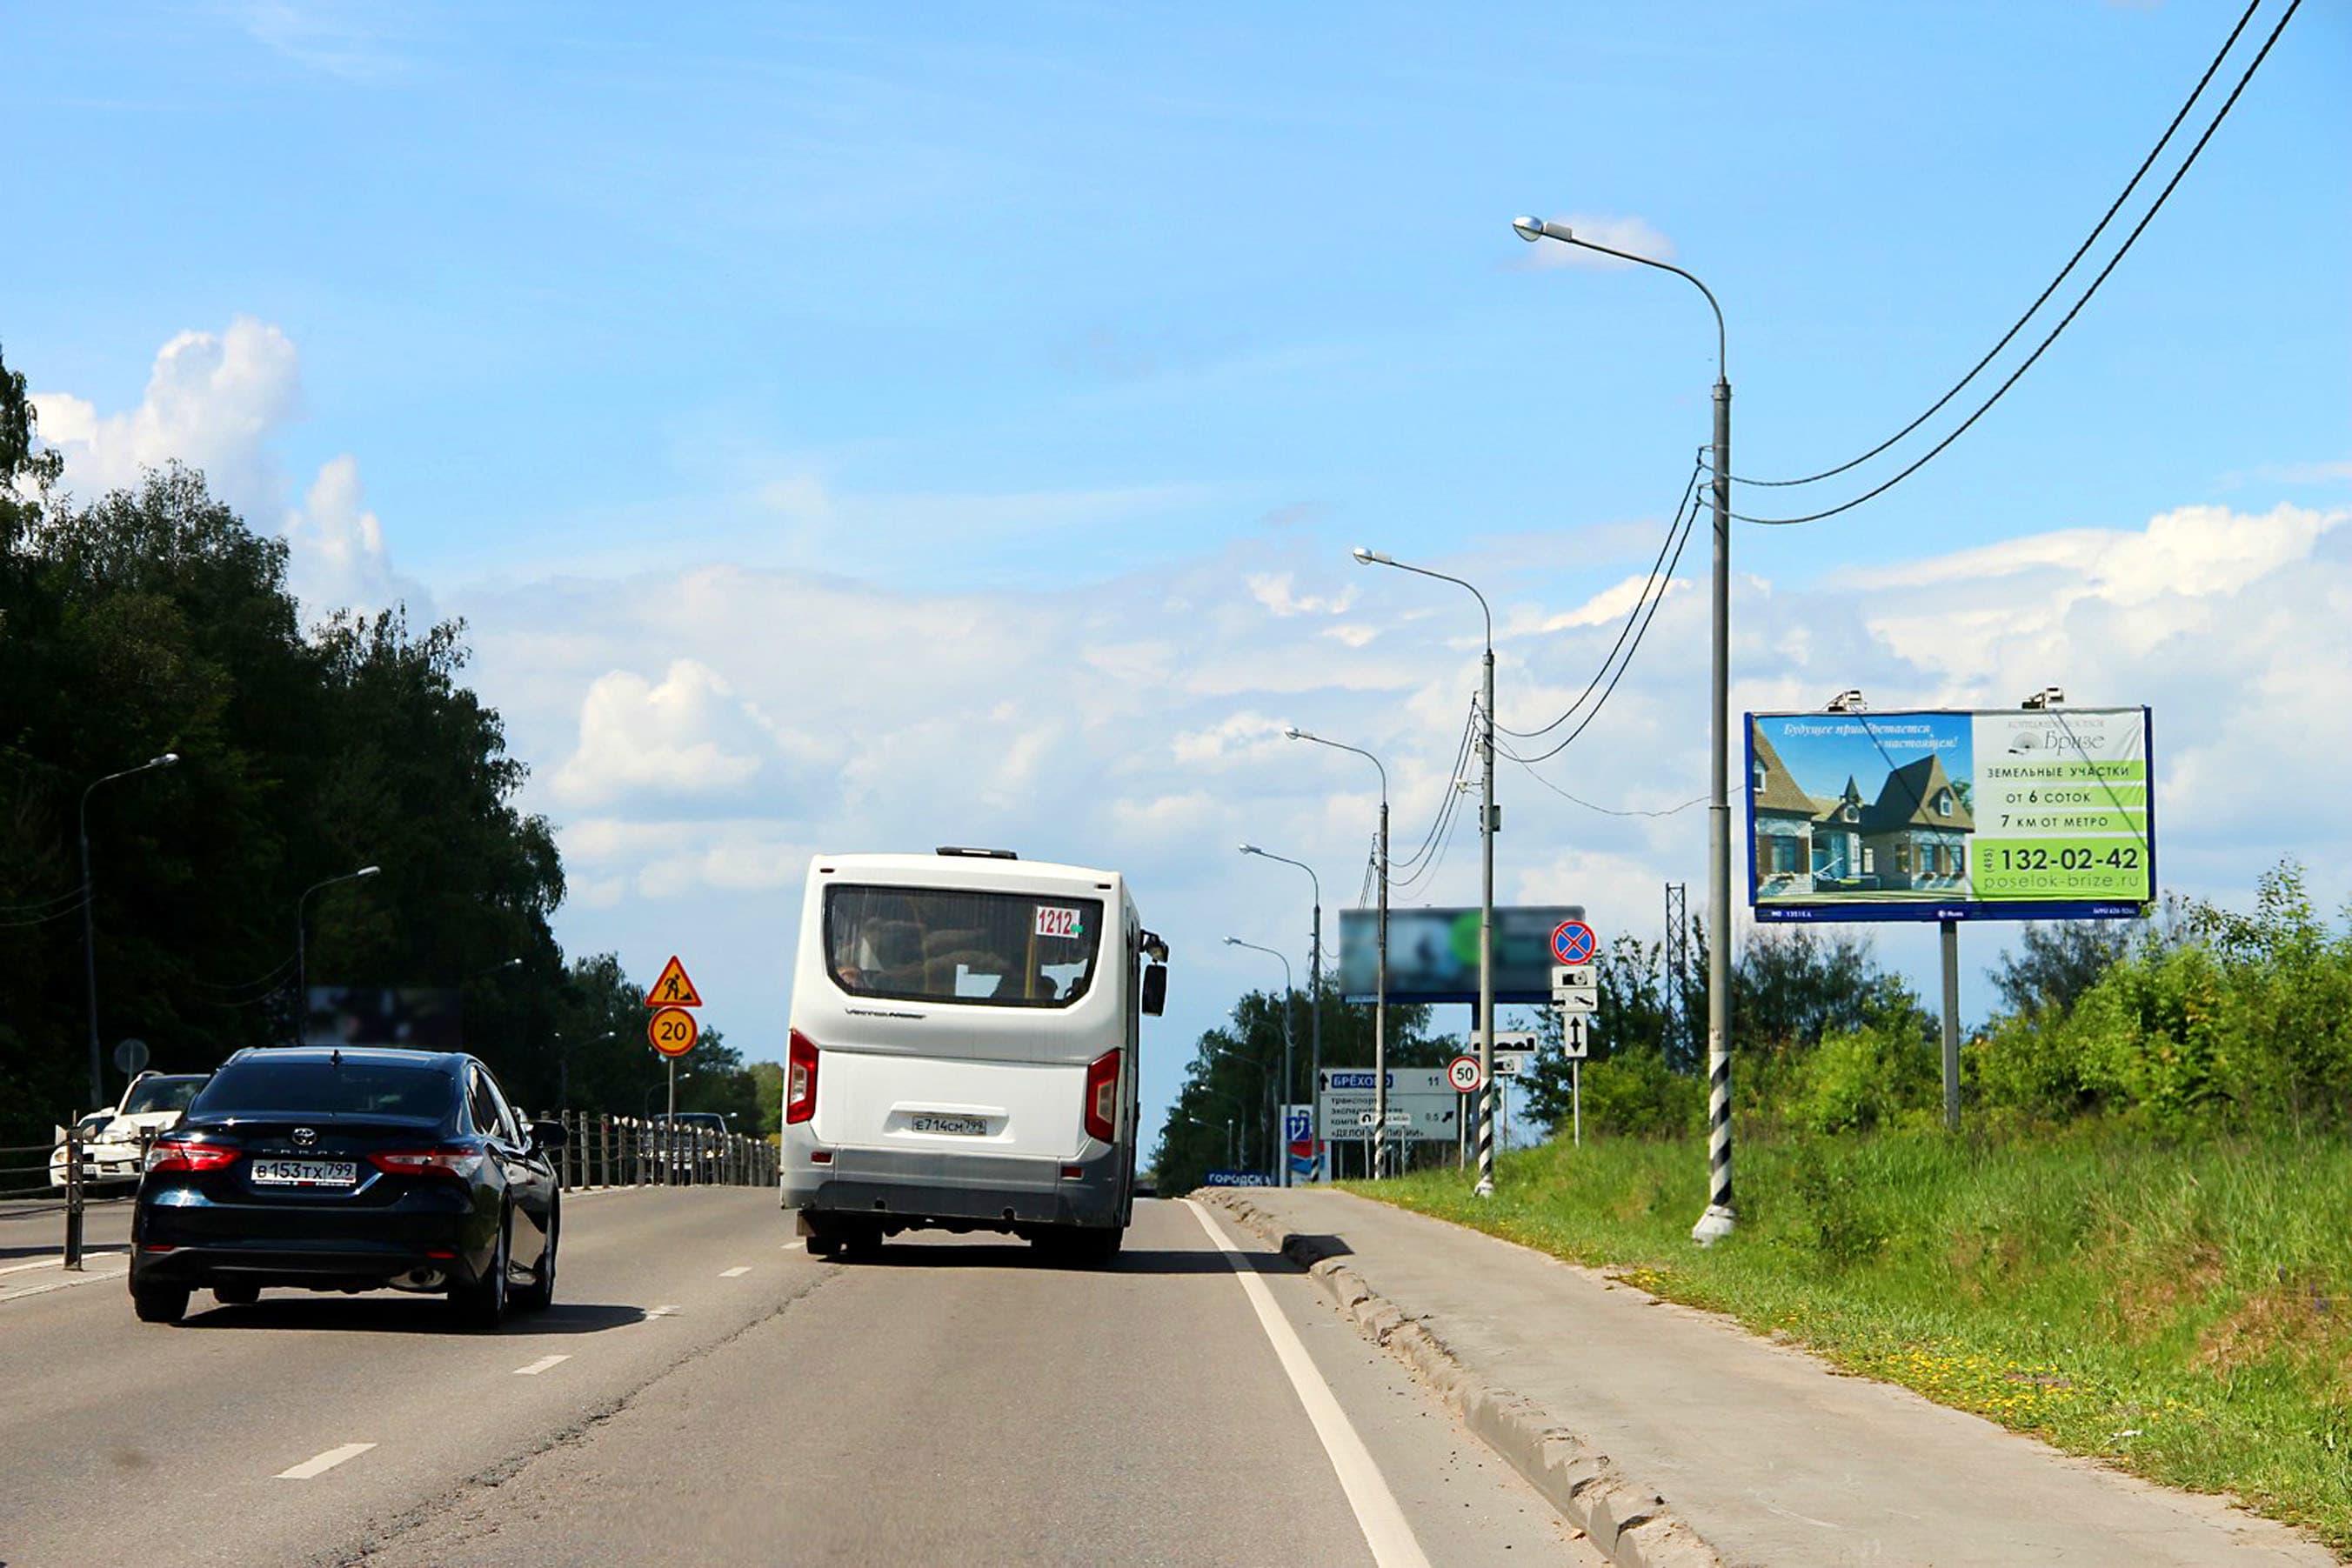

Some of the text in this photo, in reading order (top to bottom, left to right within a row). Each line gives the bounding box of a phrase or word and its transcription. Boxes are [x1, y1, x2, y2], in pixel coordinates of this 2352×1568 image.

[1988, 766, 2129, 778] ЗЕМЕЛЬНЫЕ УЧАСТКИ
[2029, 790, 2038, 804] 6
[2001, 814, 2009, 827] 7
[2002, 848, 2139, 871] 132-02-42
[1984, 872, 2139, 890] poselok-brize.ru
[1039, 909, 1072, 935] 1212
[661, 1021, 686, 1041] 20
[1333, 1075, 1440, 1087] БРЁХОО 11
[1457, 1067, 1474, 1082] 50
[257, 1163, 352, 1179] В153ТХ 799
